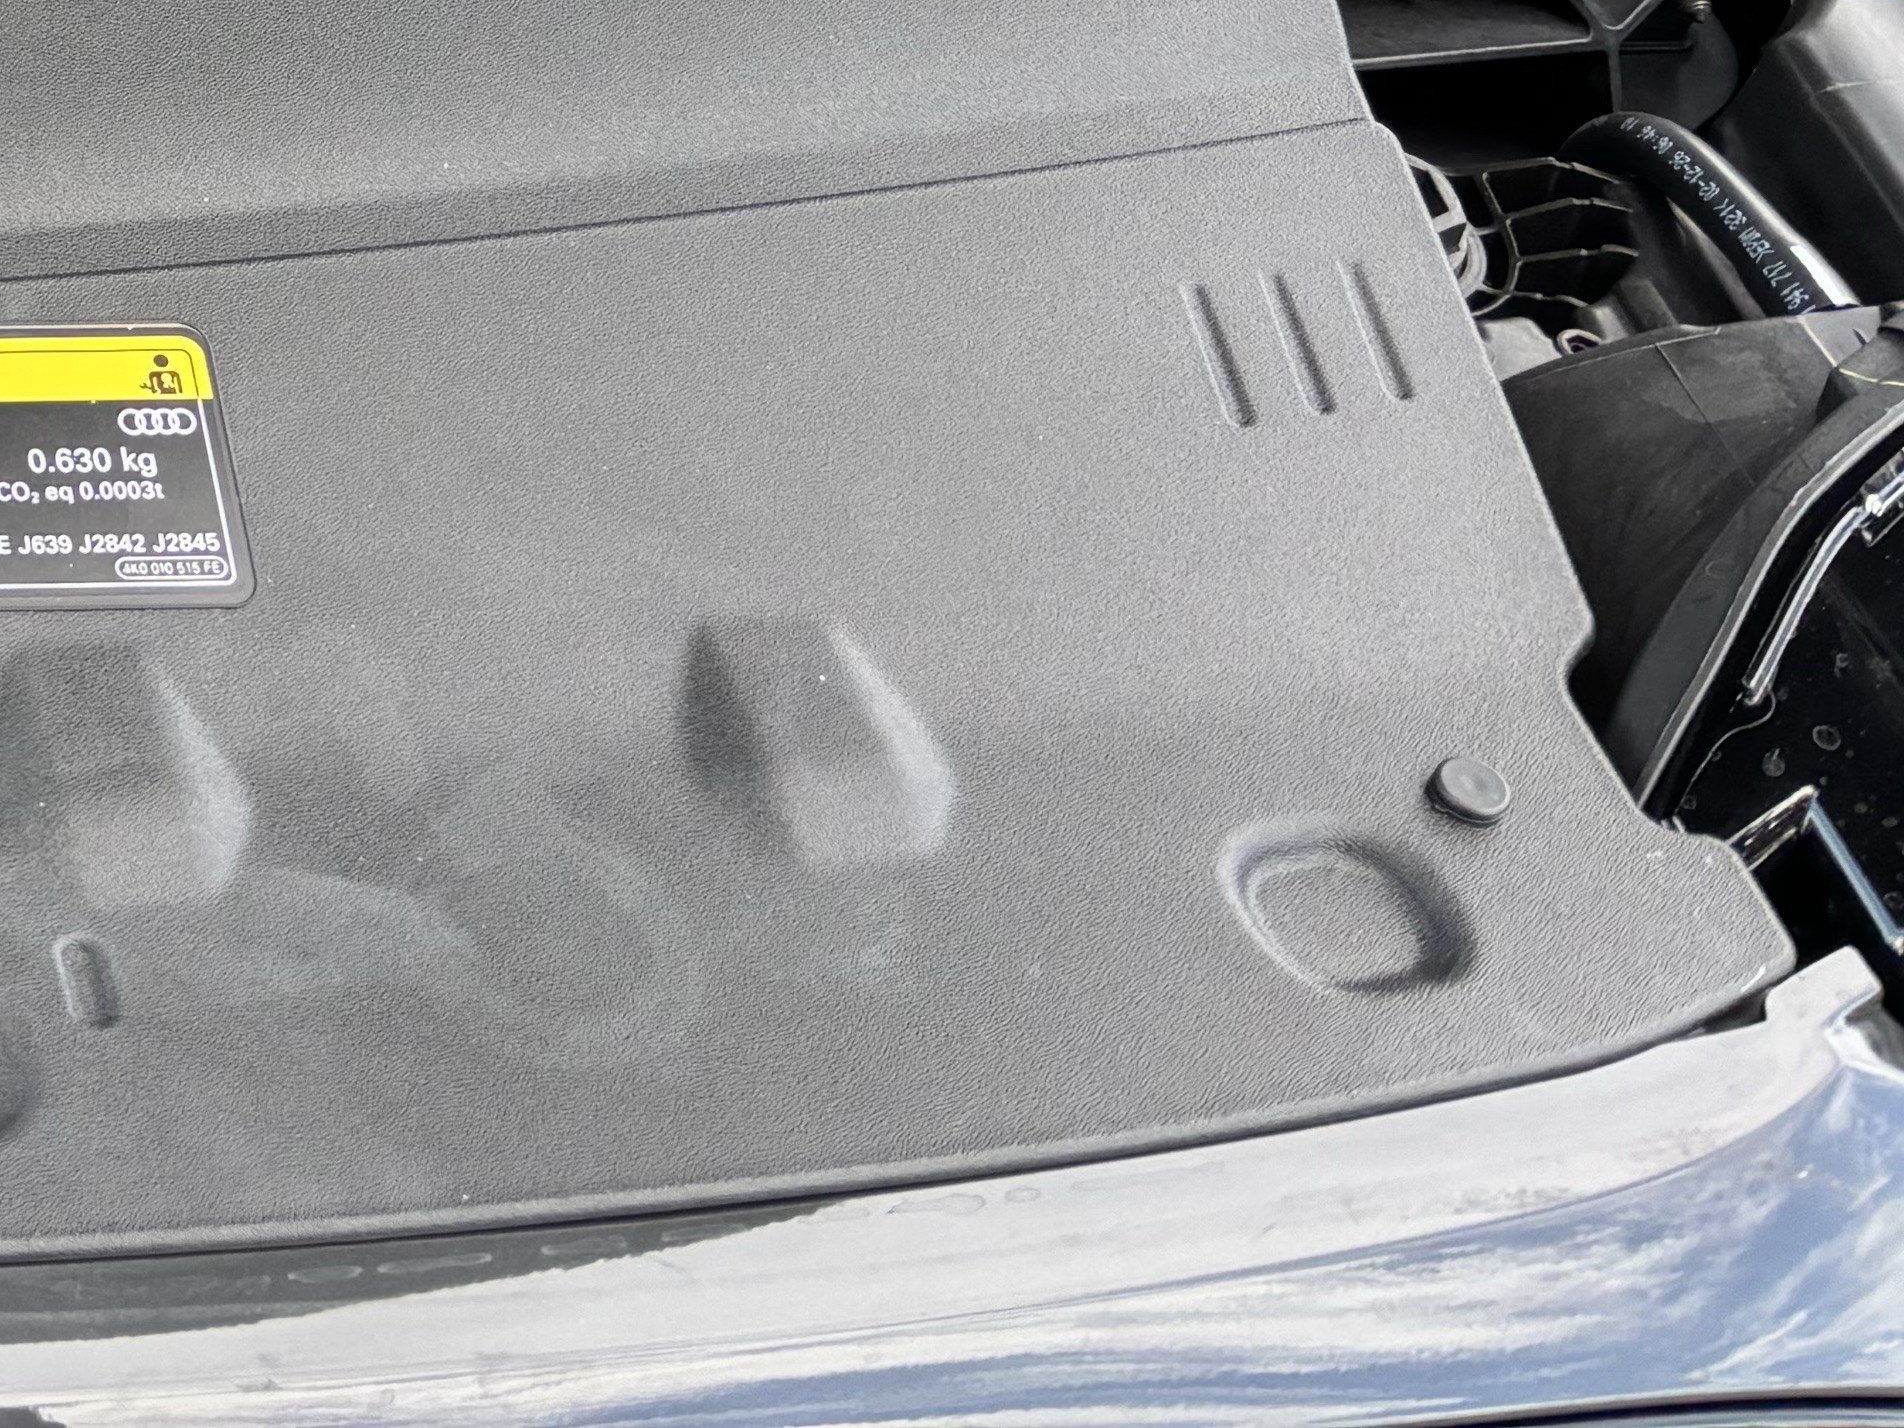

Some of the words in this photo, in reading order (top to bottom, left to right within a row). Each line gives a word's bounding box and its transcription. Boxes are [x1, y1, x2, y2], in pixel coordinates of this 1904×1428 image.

[27, 447, 112, 475] 0.630
[120, 446, 159, 477] kg
[45, 483, 75, 505] eq
[79, 480, 165, 502] 0.0003t
[18, 534, 73, 555] J639
[78, 533, 146, 554] J2842
[152, 532, 221, 553] J2845
